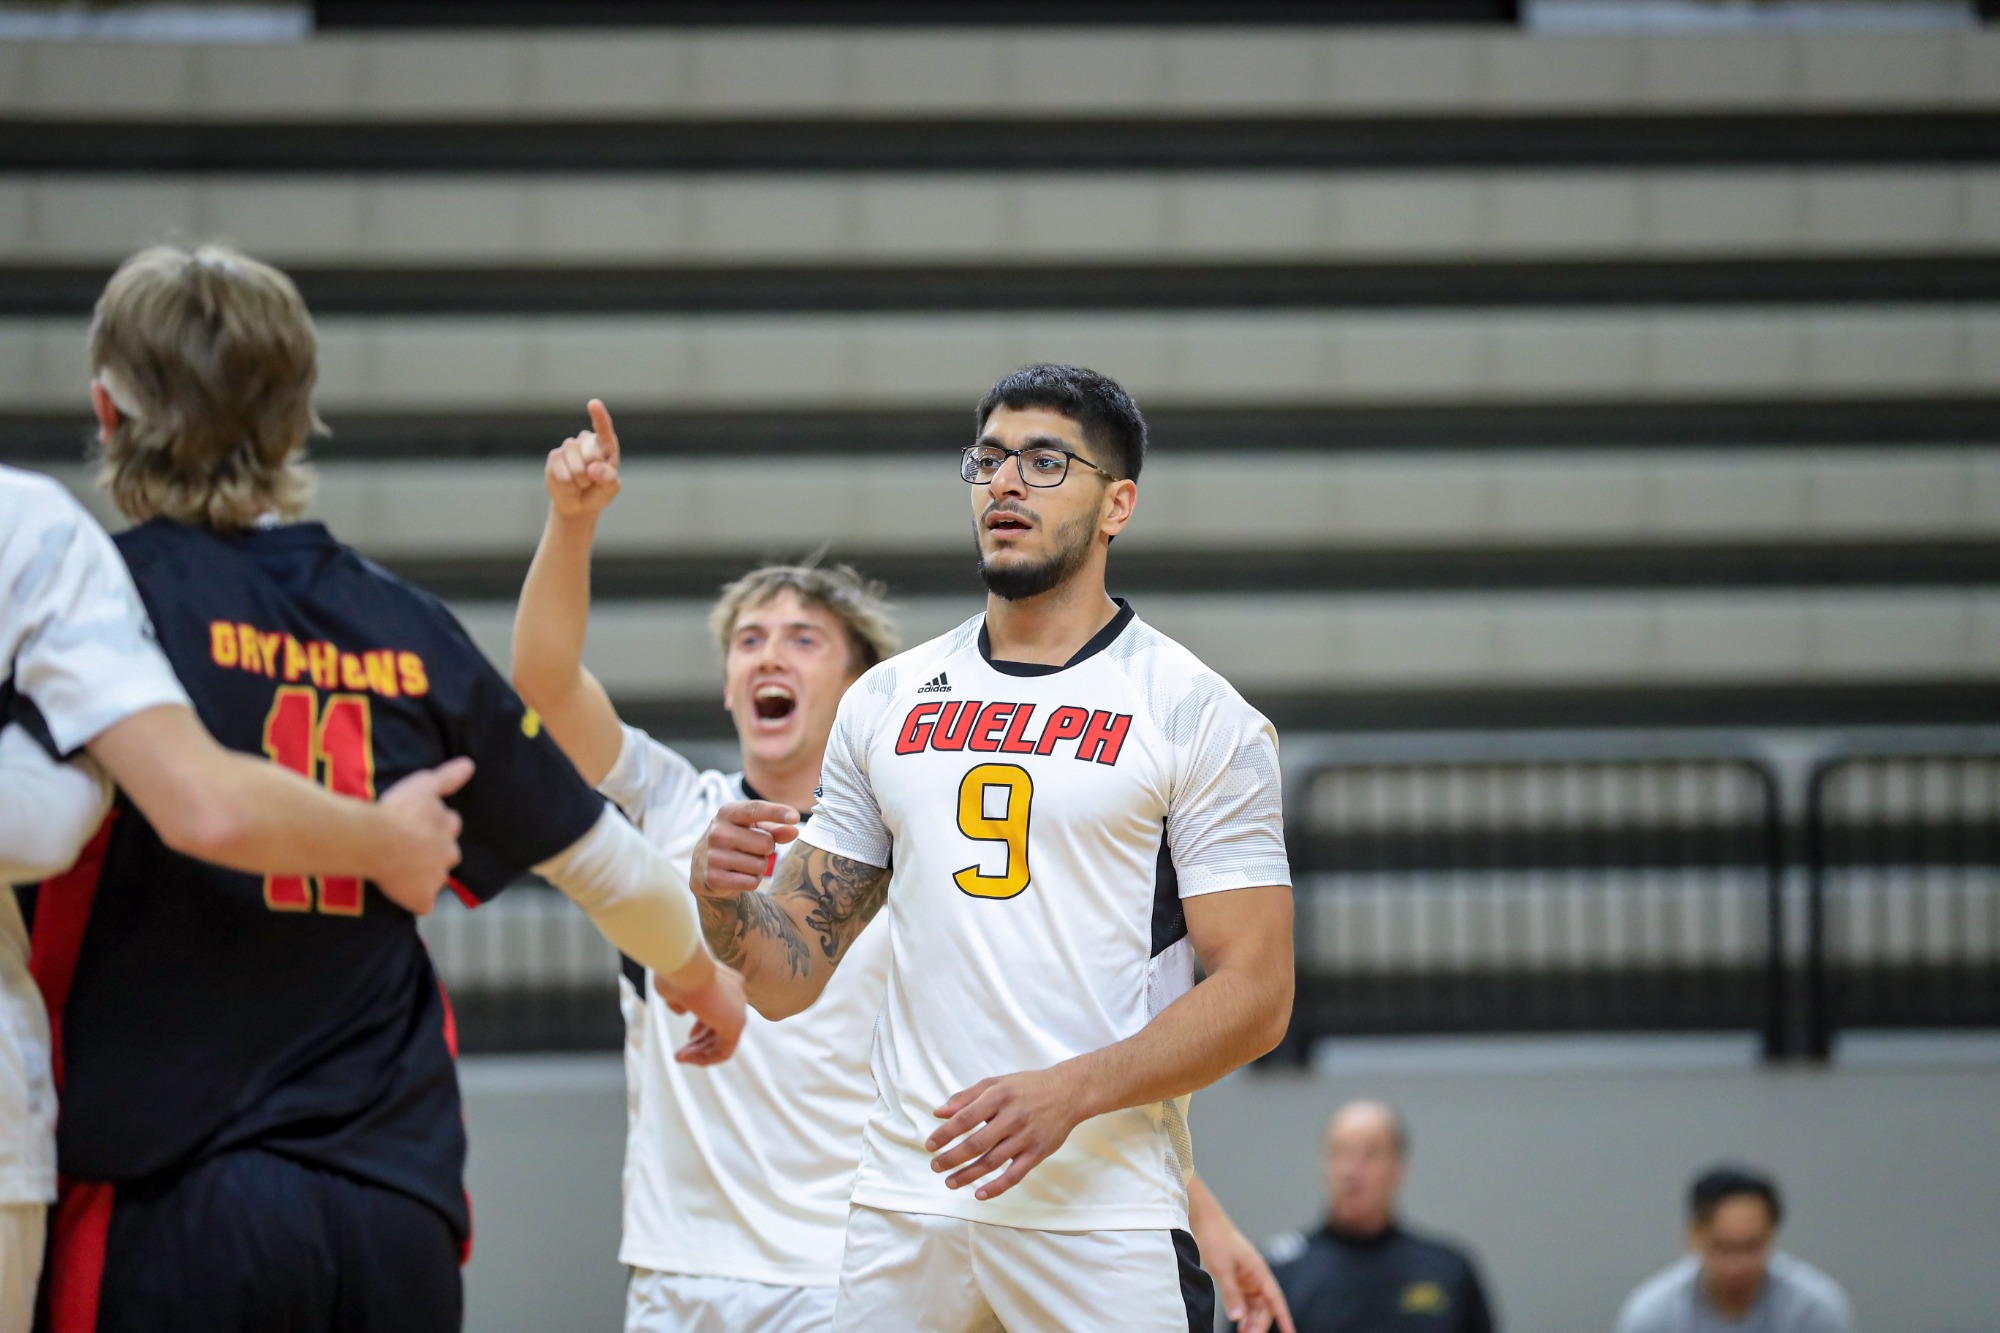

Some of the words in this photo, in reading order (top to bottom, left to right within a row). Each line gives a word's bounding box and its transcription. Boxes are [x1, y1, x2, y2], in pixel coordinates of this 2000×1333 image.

[894, 700, 1133, 767] GUELPH
[917, 684, 952, 694] adidas
[262, 684, 376, 918] 11
[952, 763, 1034, 900] 9
